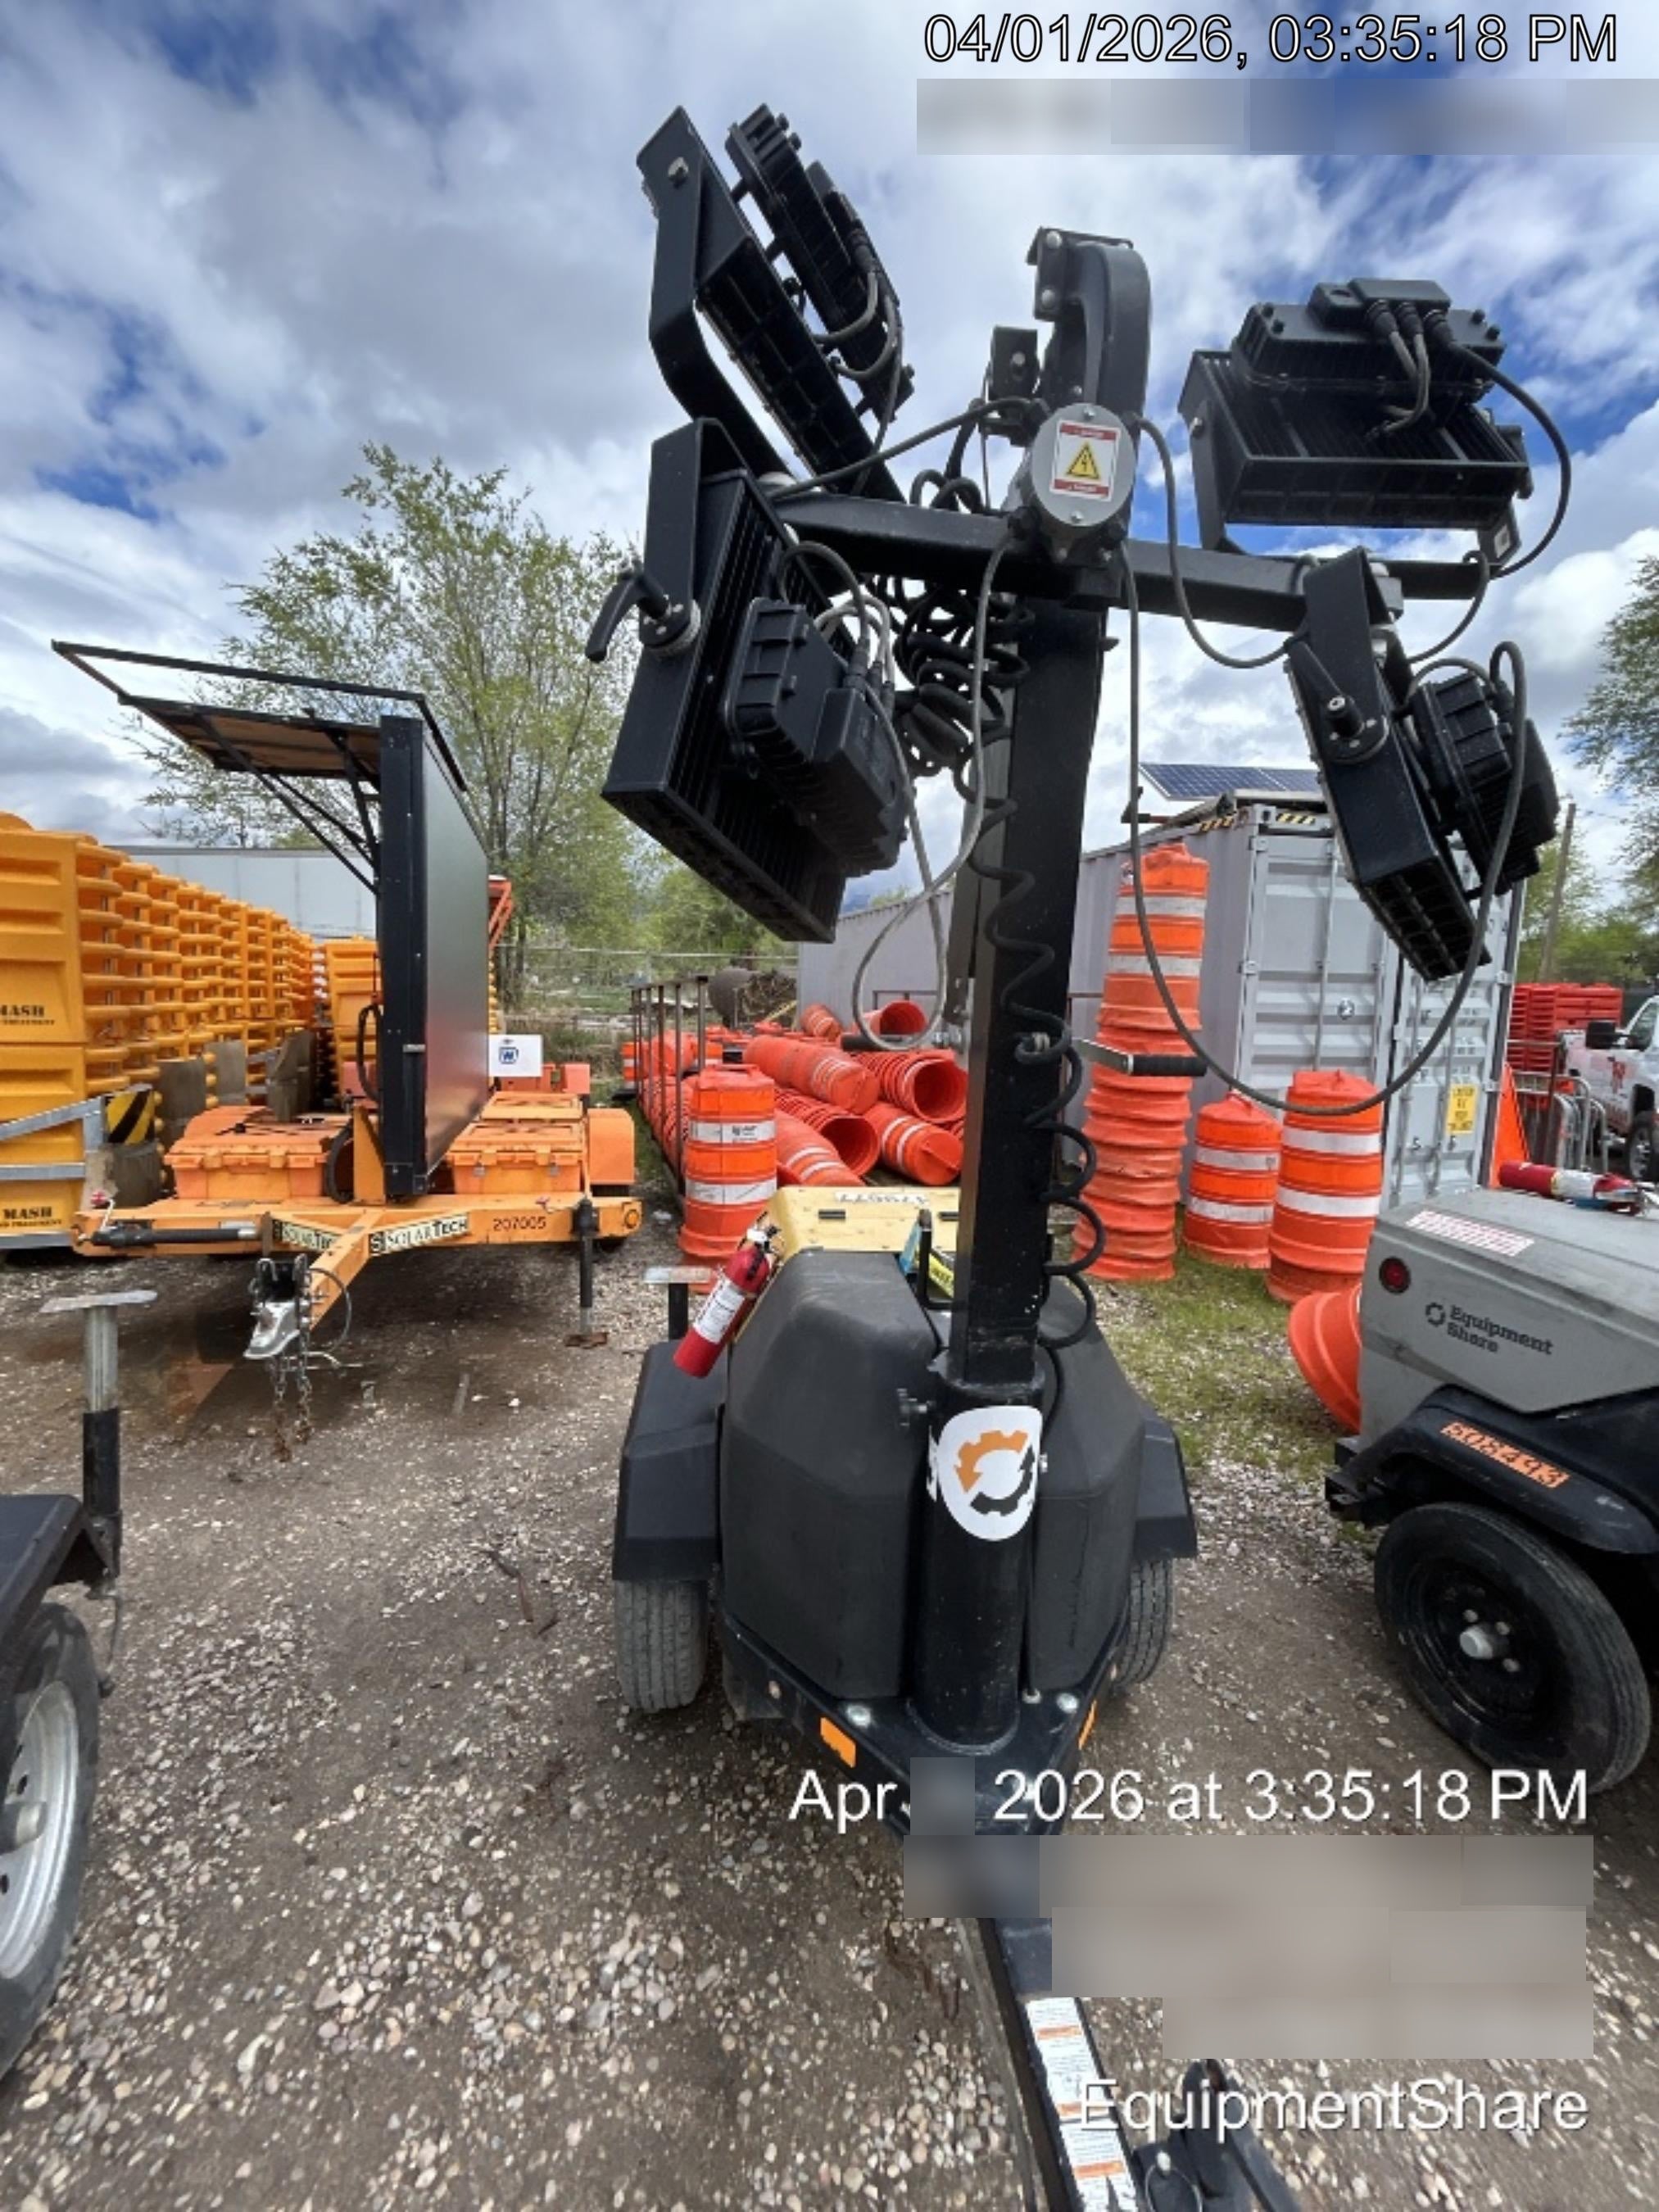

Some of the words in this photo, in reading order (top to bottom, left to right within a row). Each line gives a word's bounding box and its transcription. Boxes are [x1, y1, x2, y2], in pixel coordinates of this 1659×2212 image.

[4, 1206, 52, 1220] MASH
[493, 1216, 546, 1231] 207005
[1450, 1304, 1553, 1355] Equipment
